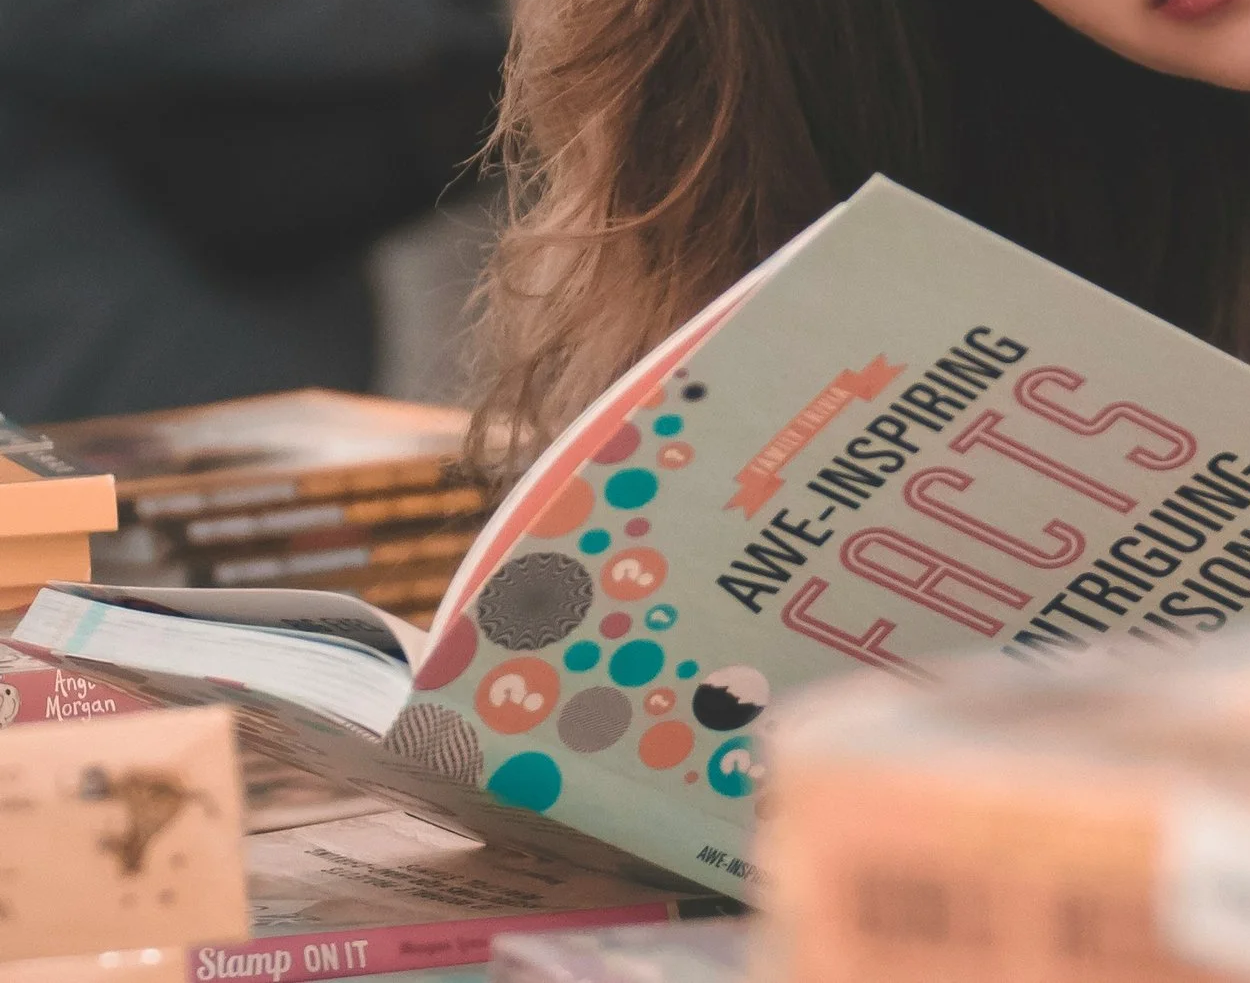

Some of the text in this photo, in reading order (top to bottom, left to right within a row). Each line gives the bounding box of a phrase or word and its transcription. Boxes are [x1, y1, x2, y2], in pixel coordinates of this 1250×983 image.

[716, 326, 1029, 613] AWE-INSPIRING
[780, 365, 1198, 686] FACTS
[46, 695, 116, 722] Morgan
[197, 947, 292, 982] Stamp
[303, 943, 339, 973] ON
[344, 940, 368, 969] IT
